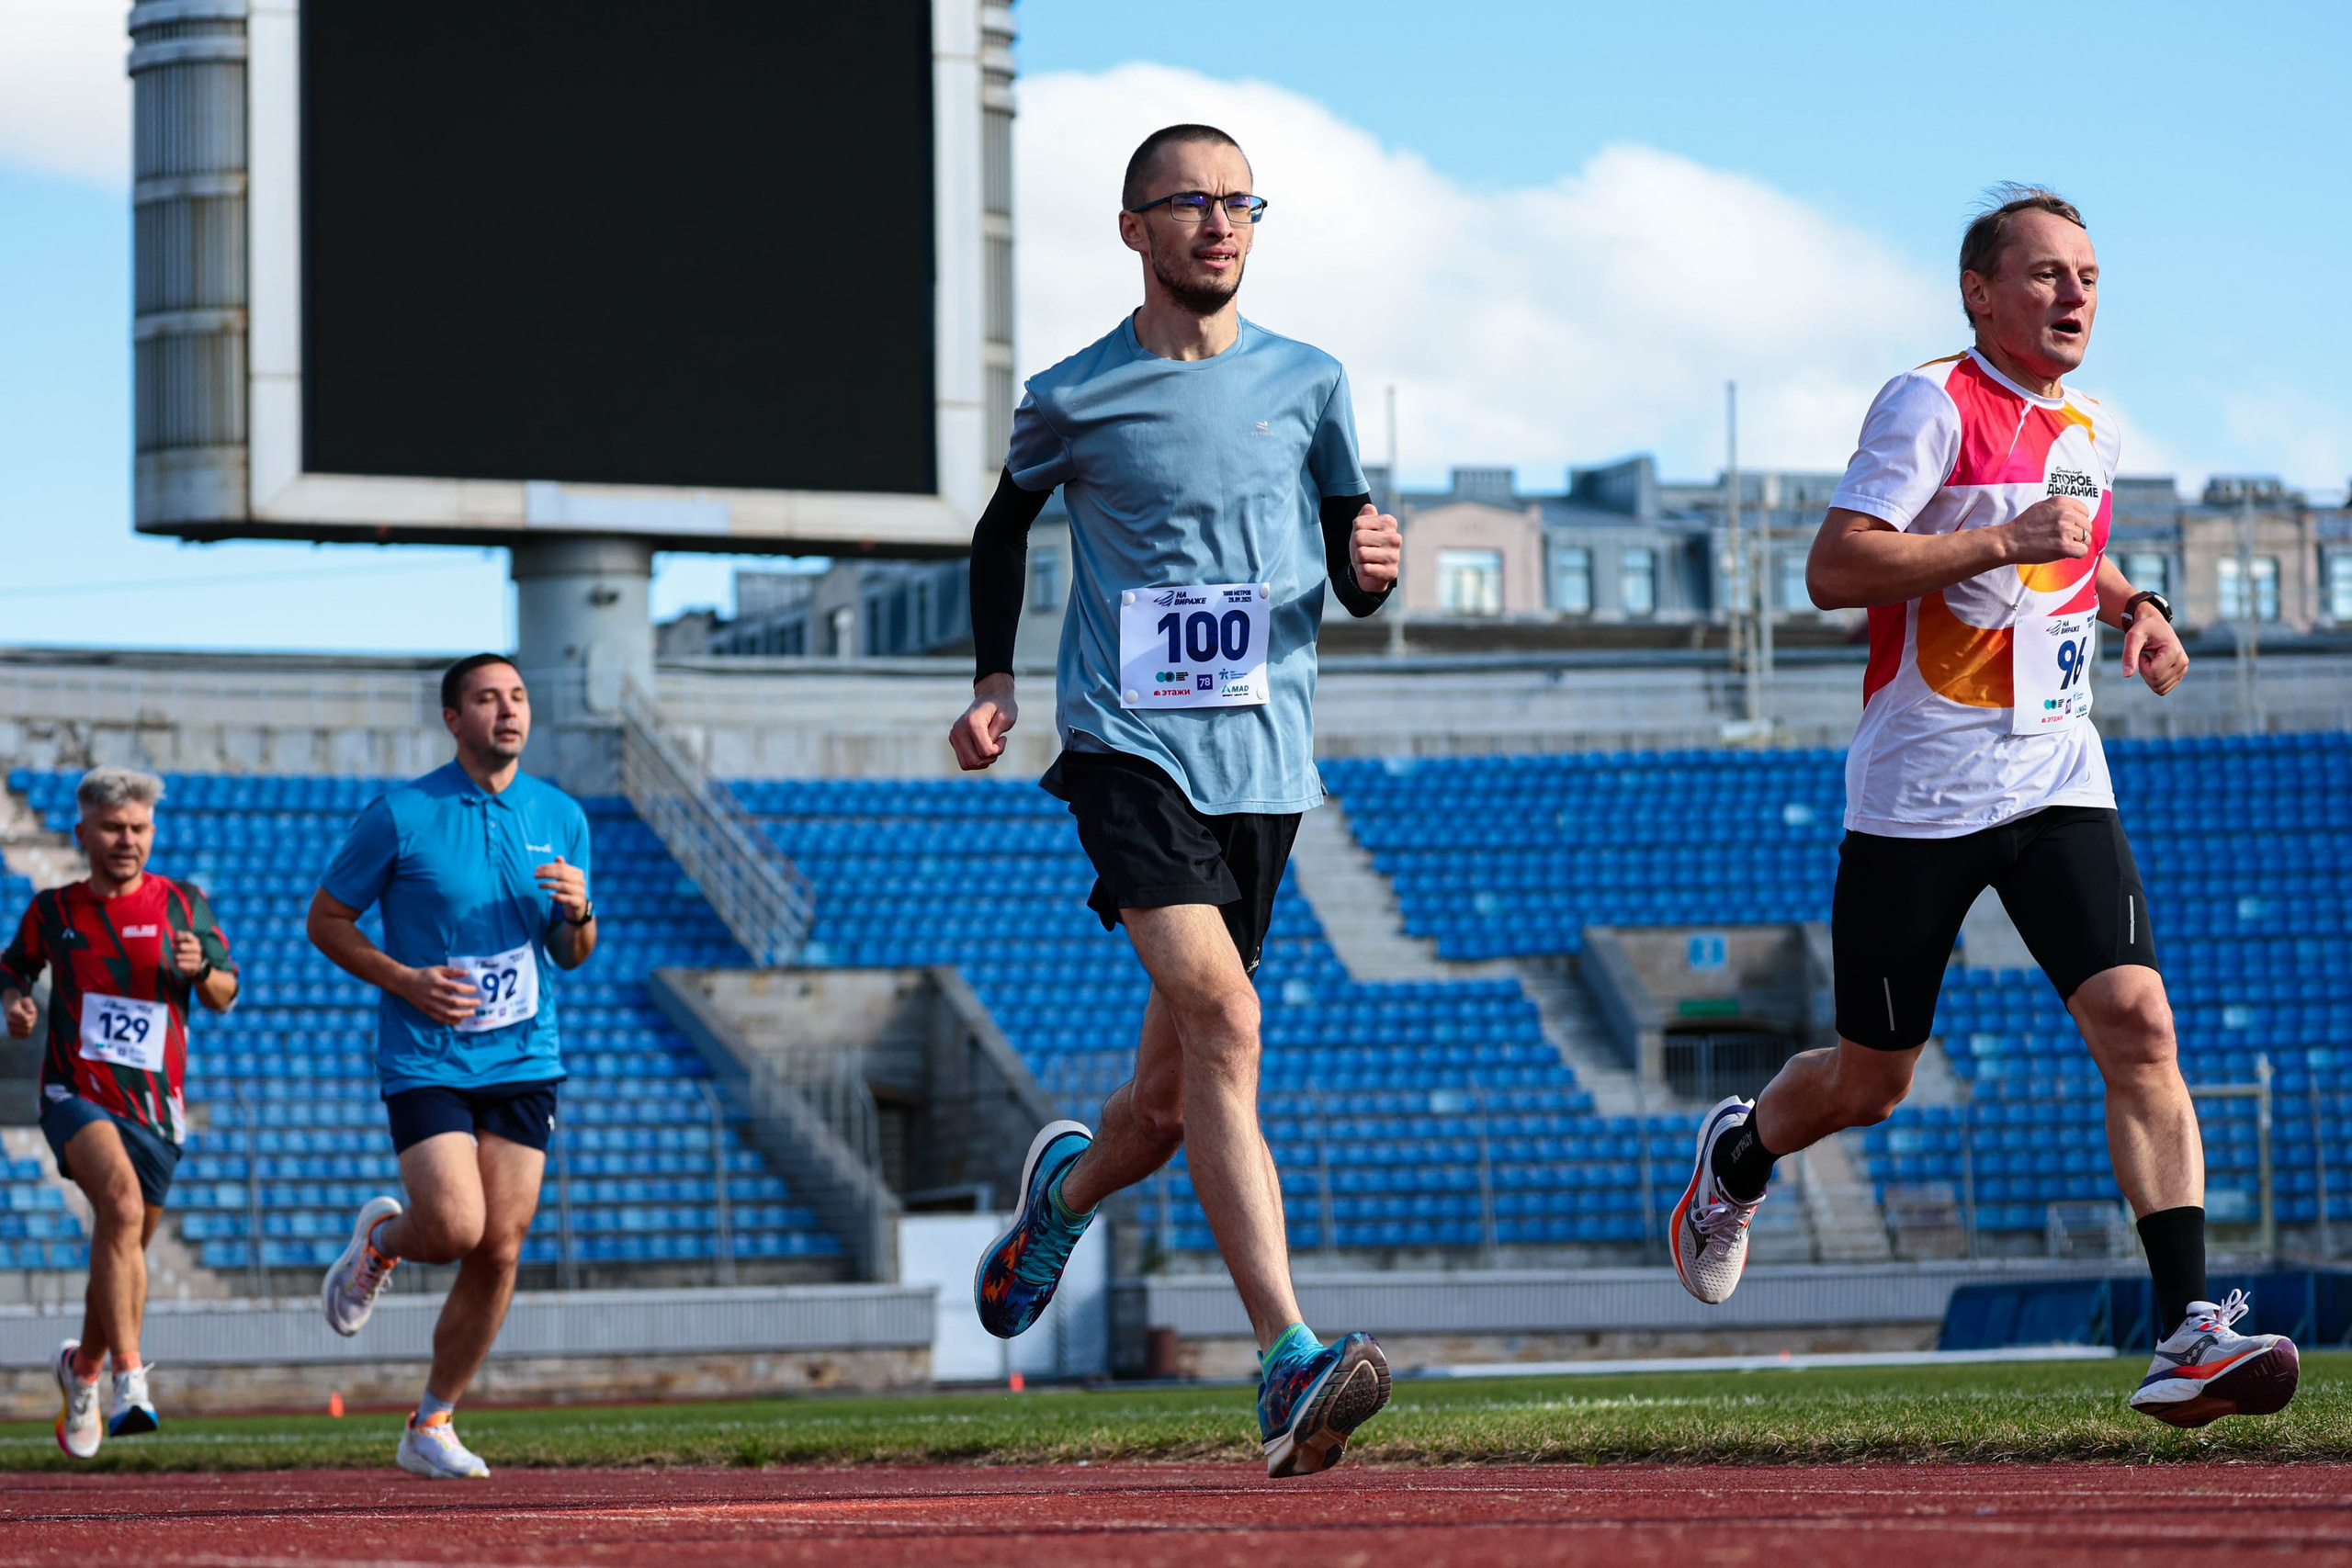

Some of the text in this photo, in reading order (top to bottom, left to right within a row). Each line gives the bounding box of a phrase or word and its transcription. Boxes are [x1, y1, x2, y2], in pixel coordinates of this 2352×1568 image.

[2047, 484, 2098, 498] ДЫХАНИЕ
[2051, 473, 2092, 486] ВТОРОЕ
[1158, 609, 1250, 663] 100
[2058, 636, 2087, 690] 96
[1199, 677, 1211, 687] 78
[482, 968, 517, 1003] 92
[99, 1012, 150, 1043] 129
